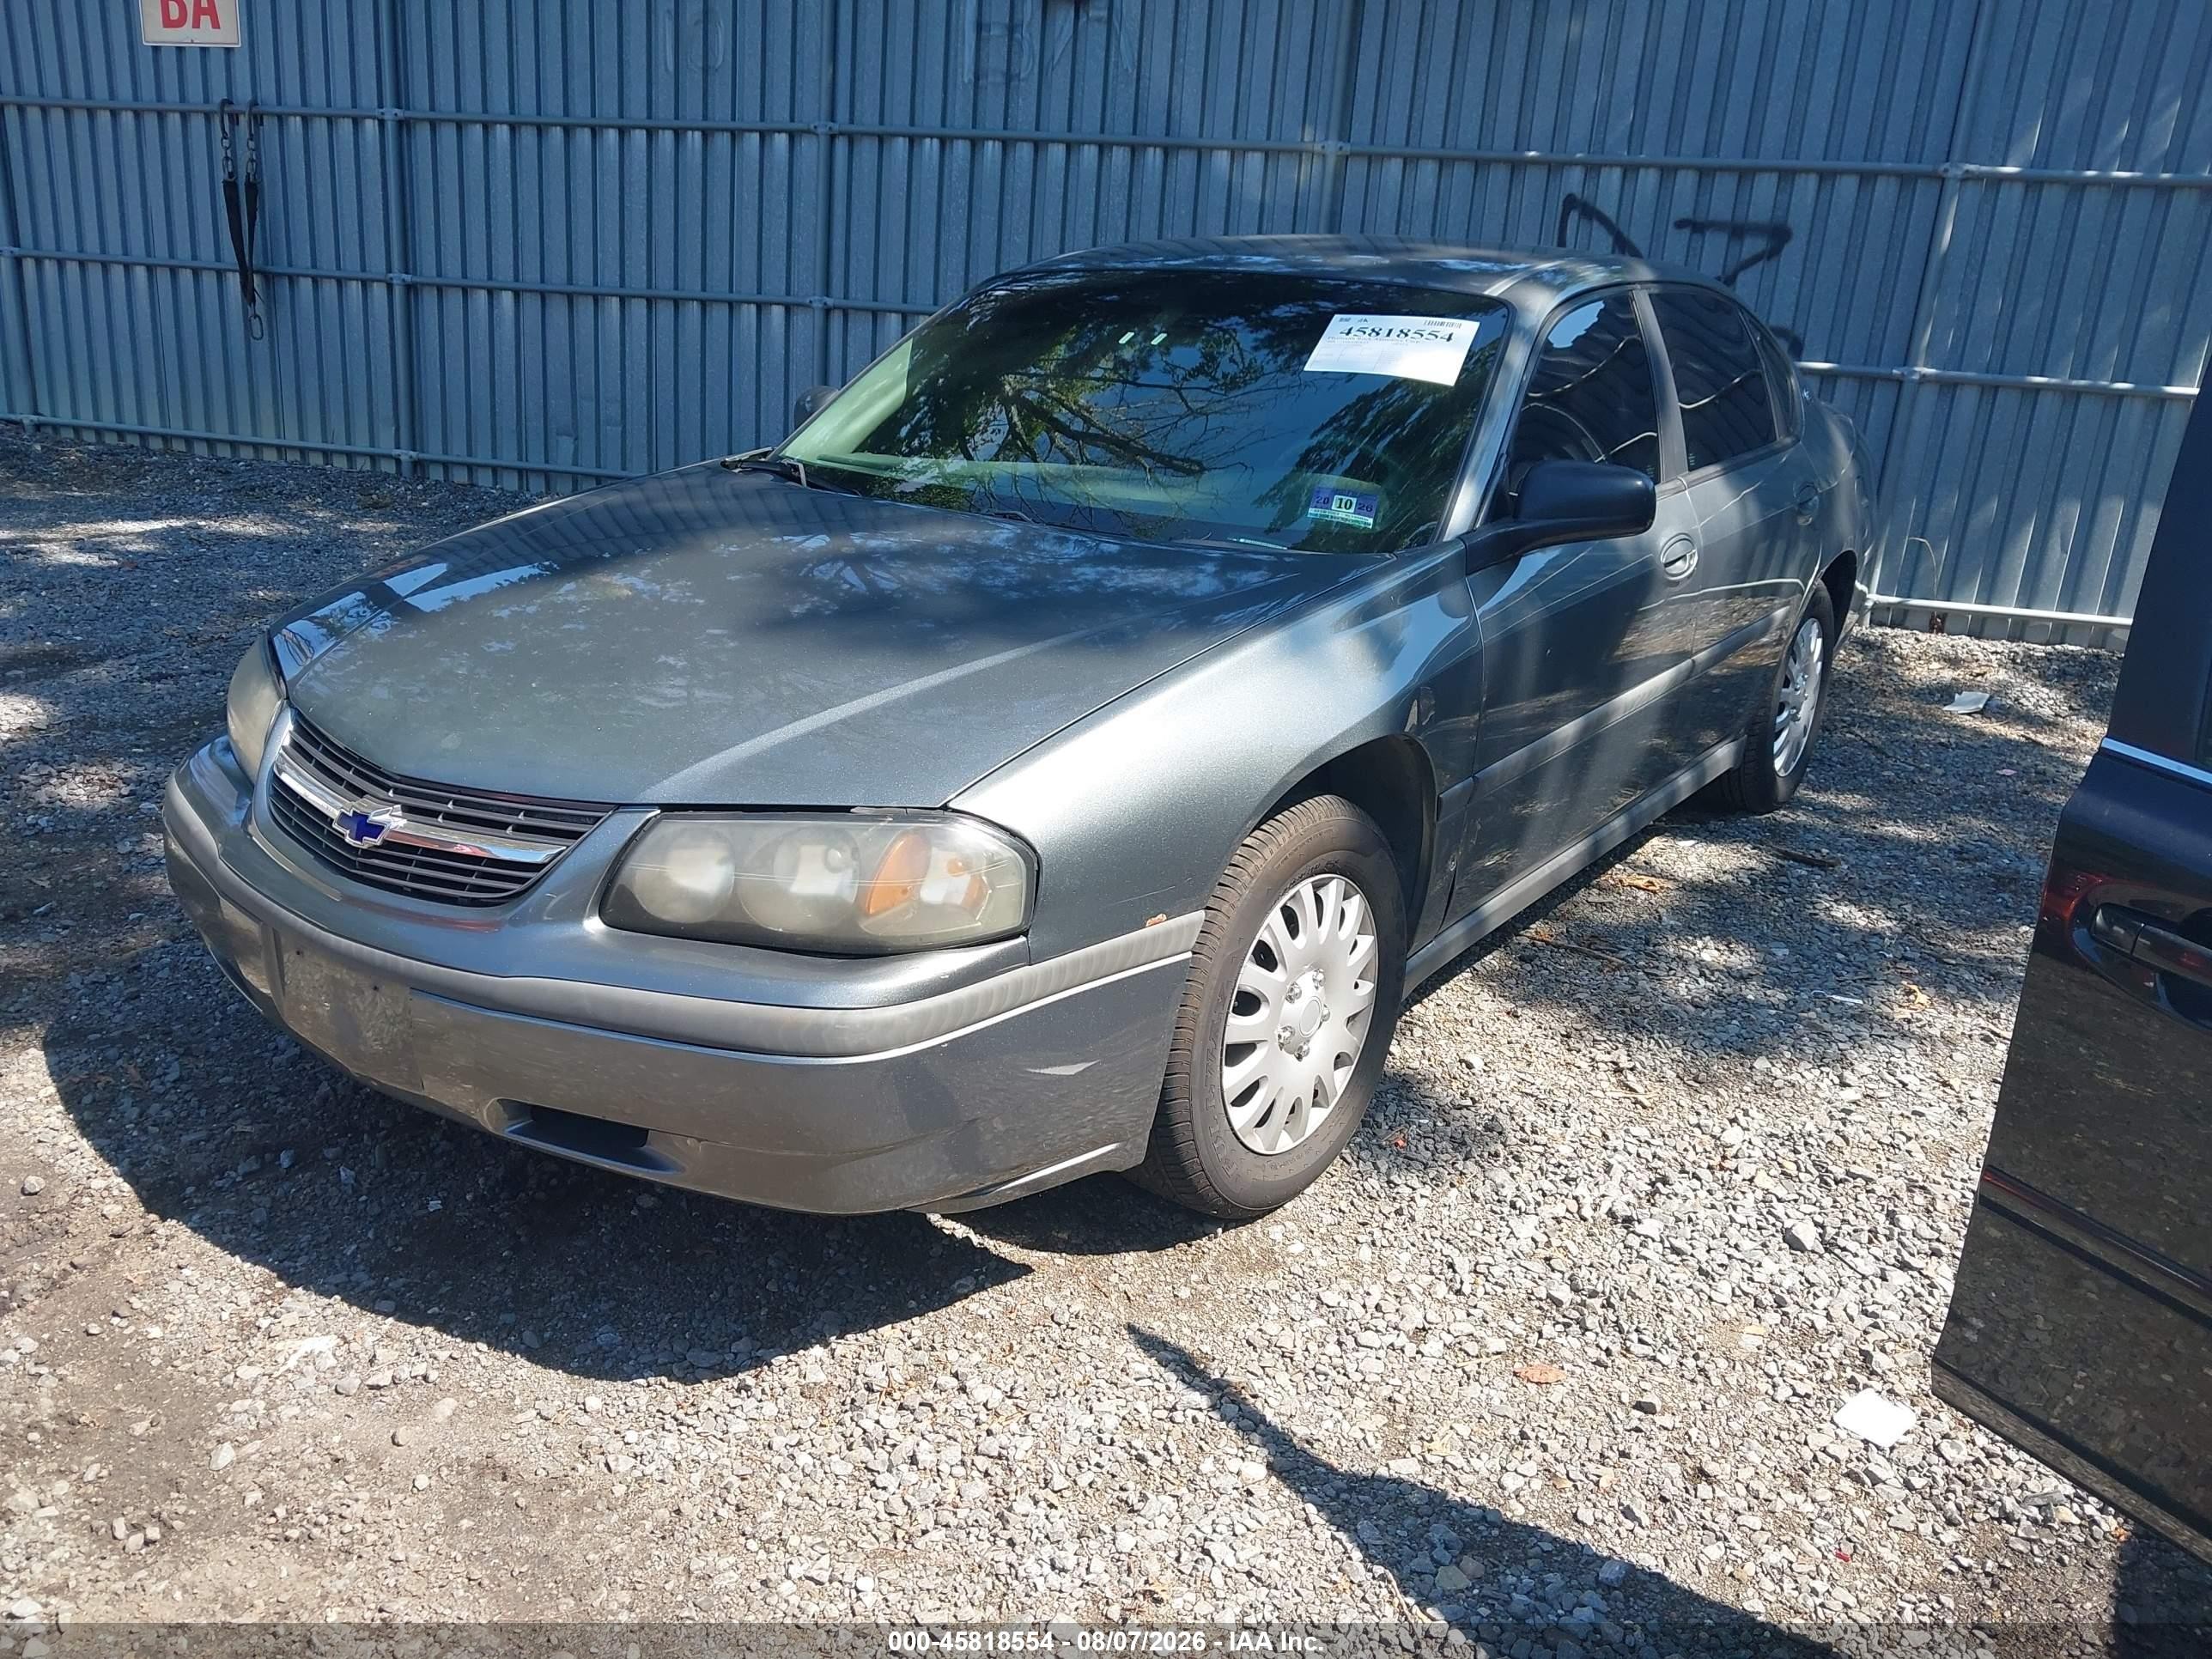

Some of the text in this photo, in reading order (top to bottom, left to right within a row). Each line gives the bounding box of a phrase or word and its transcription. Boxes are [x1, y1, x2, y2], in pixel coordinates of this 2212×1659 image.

[1340, 326, 1454, 342] 45818554
[1316, 495, 1373, 512] 20 10 26
